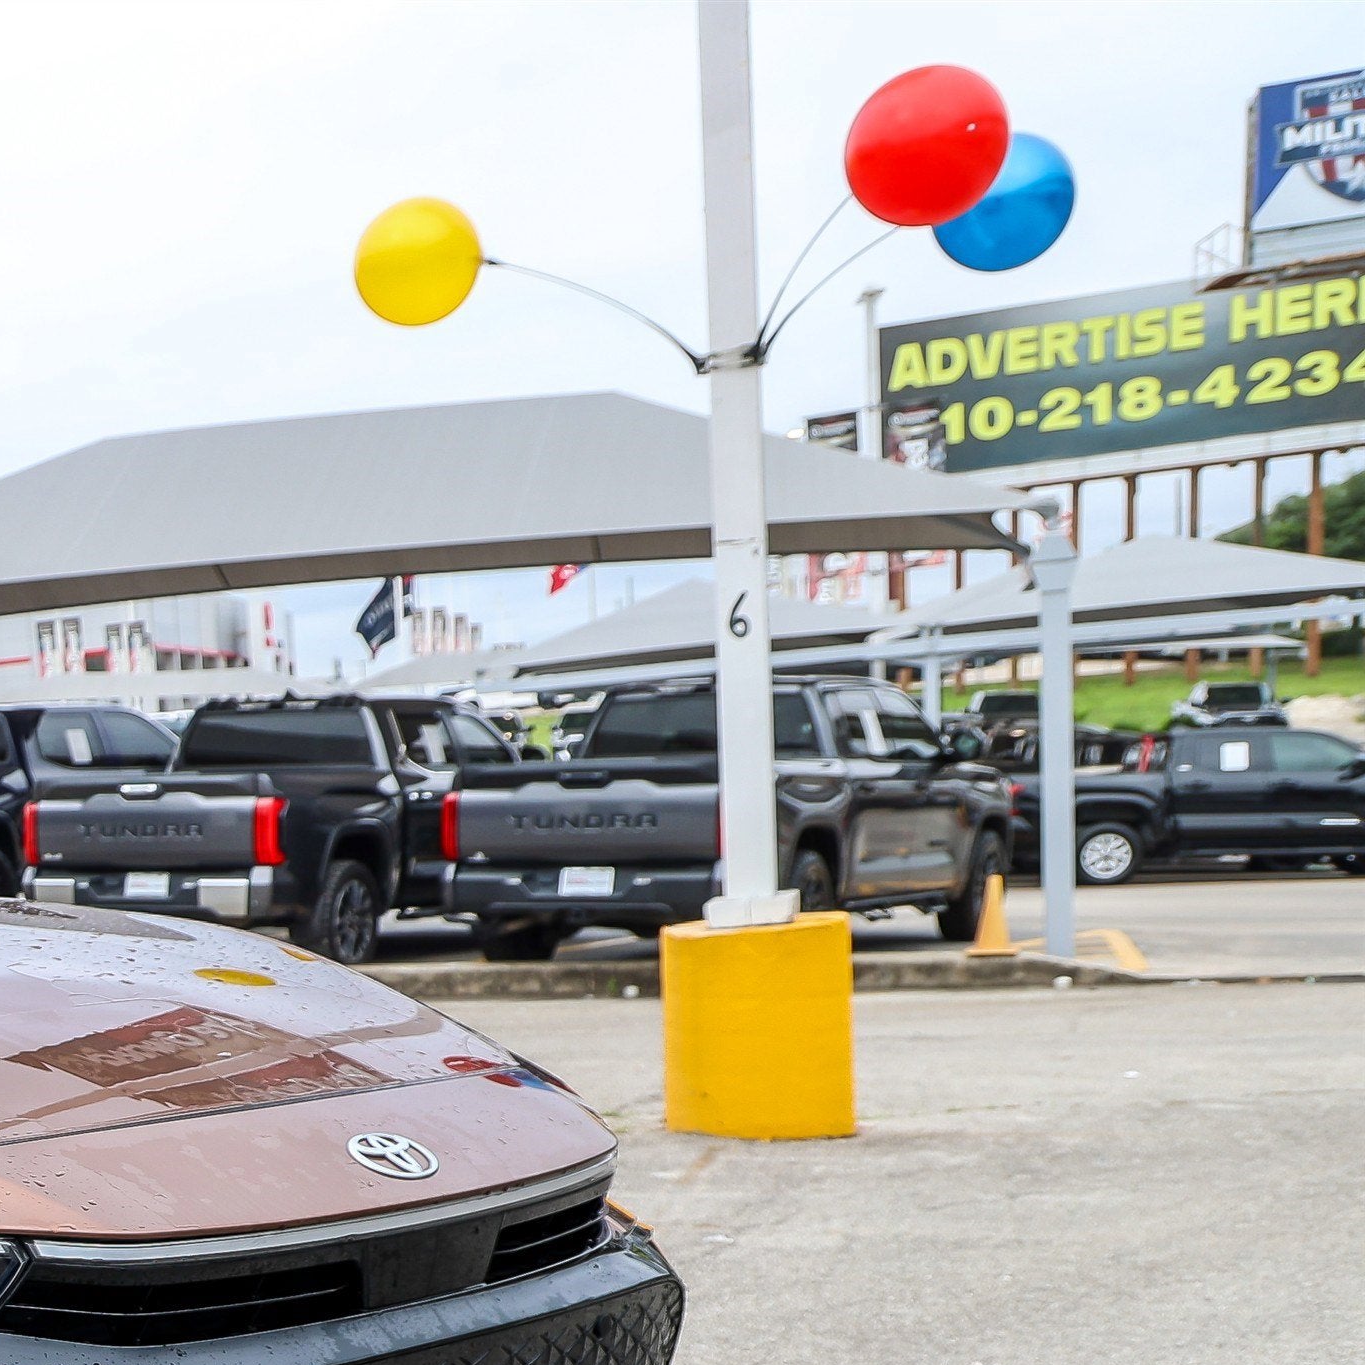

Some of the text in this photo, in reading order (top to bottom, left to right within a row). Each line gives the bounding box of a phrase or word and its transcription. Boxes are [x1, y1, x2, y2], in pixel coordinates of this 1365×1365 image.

[887, 275, 1365, 392] ADVERTISE HER
[729, 590, 748, 638] 6
[78, 824, 205, 842] TUNDRA
[506, 813, 659, 835] TUNDRA
